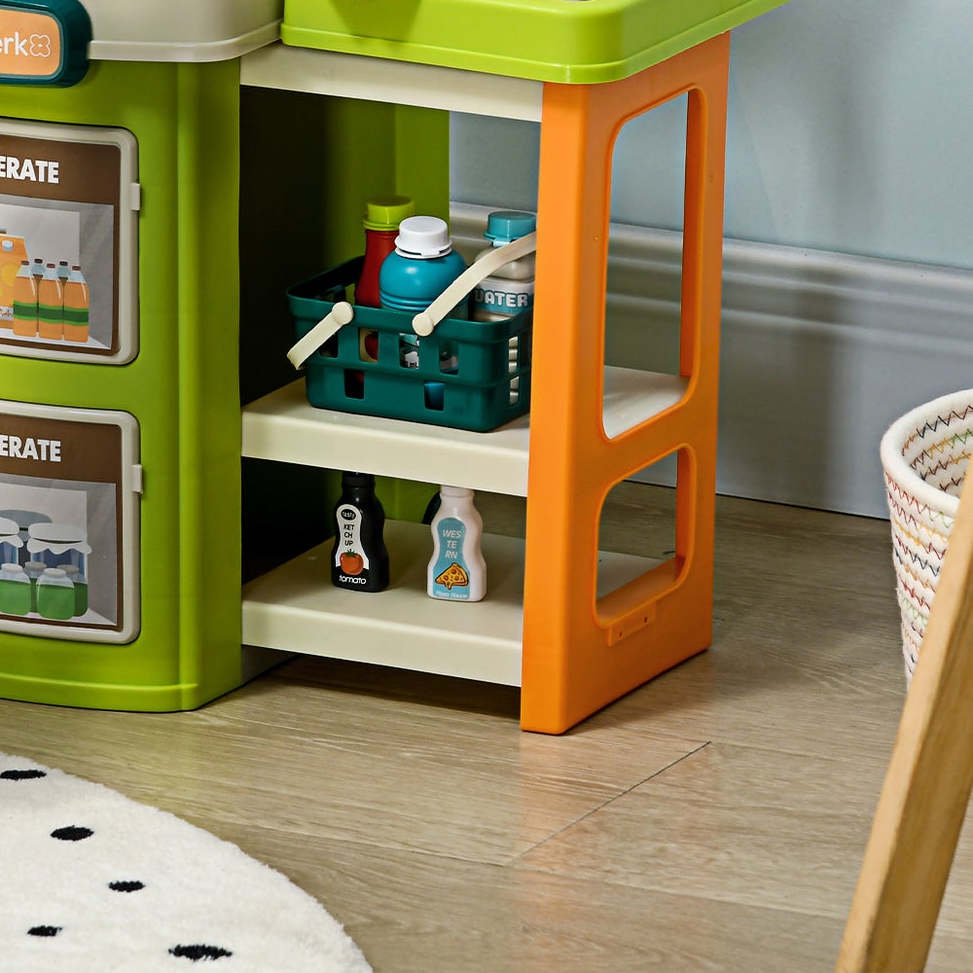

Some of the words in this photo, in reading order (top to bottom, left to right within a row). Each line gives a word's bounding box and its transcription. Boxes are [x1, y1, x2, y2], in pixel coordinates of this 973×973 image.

[442, 529, 462, 539] WES
[447, 540, 458, 549] TE
[445, 550, 458, 559] RN
[338, 575, 367, 585] tomato
